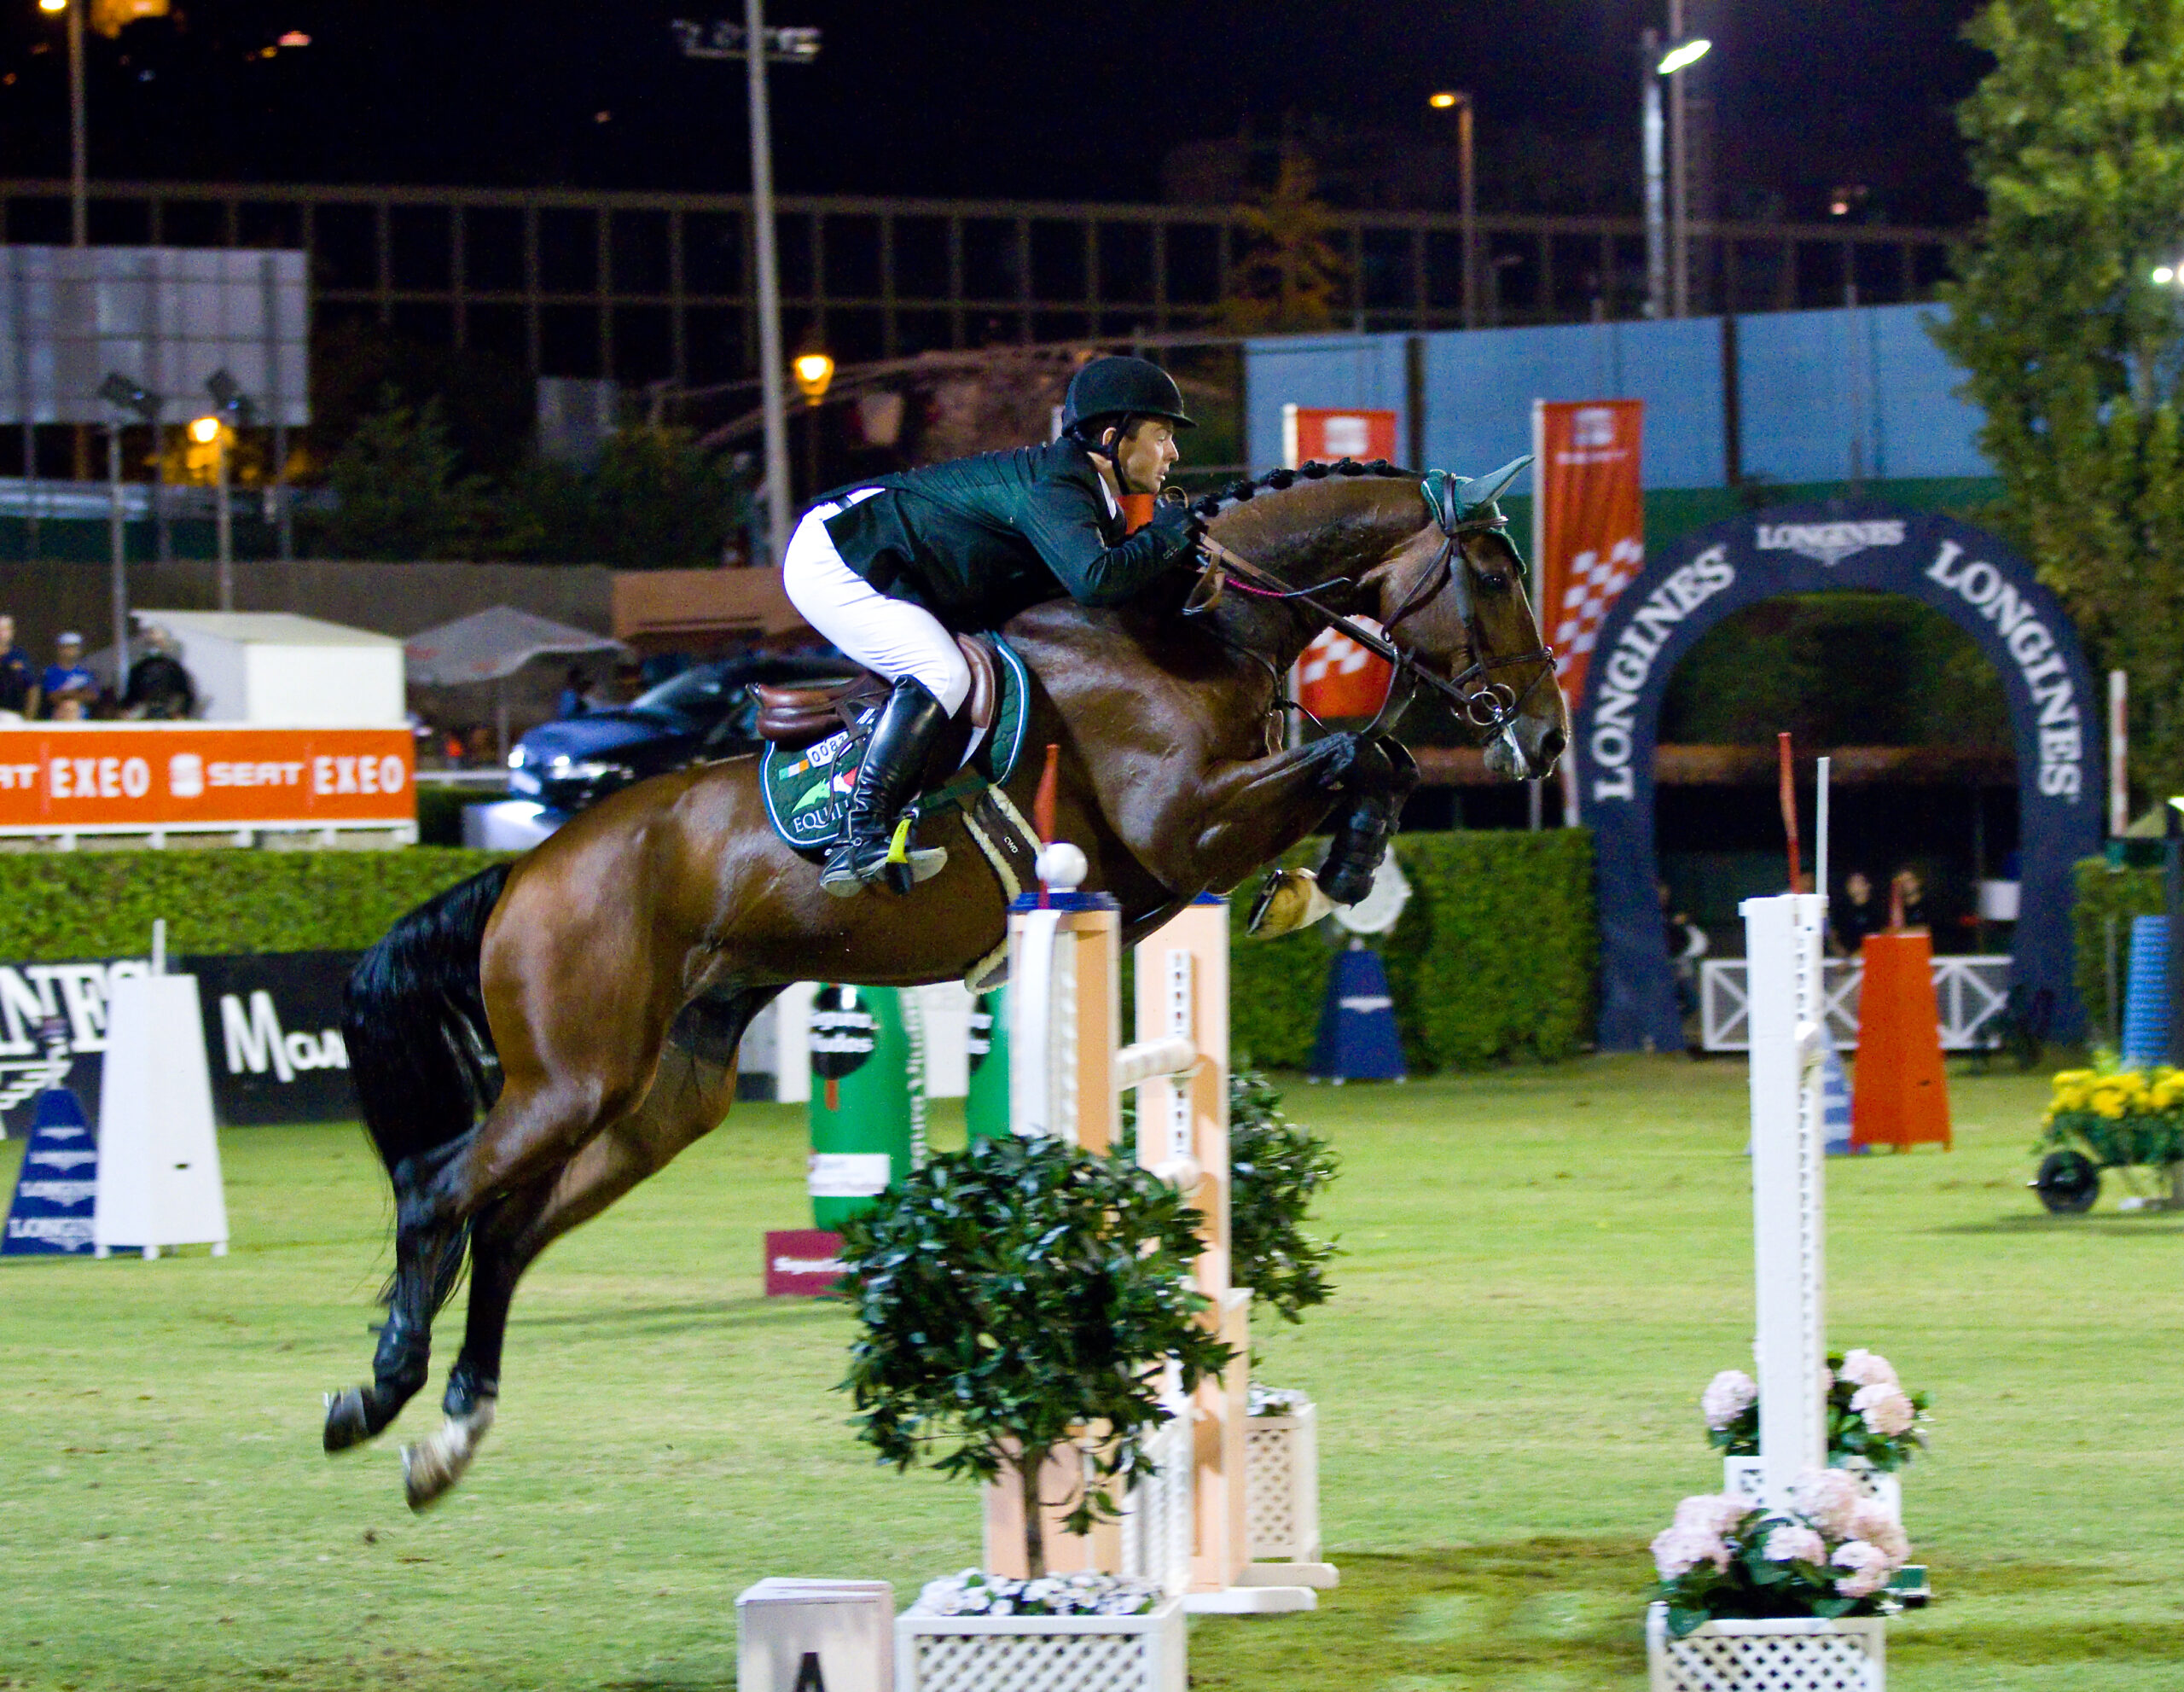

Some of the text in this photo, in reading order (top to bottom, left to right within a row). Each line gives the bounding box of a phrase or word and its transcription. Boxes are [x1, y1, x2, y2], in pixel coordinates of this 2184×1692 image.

[1757, 520, 1907, 549] LONGINES
[1591, 544, 1736, 803] LONGINES
[1925, 540, 2082, 799] LONGINES
[49, 757, 150, 798] EXEO
[207, 754, 405, 795] SEAT EXEO
[1003, 836, 1019, 853] CWD
